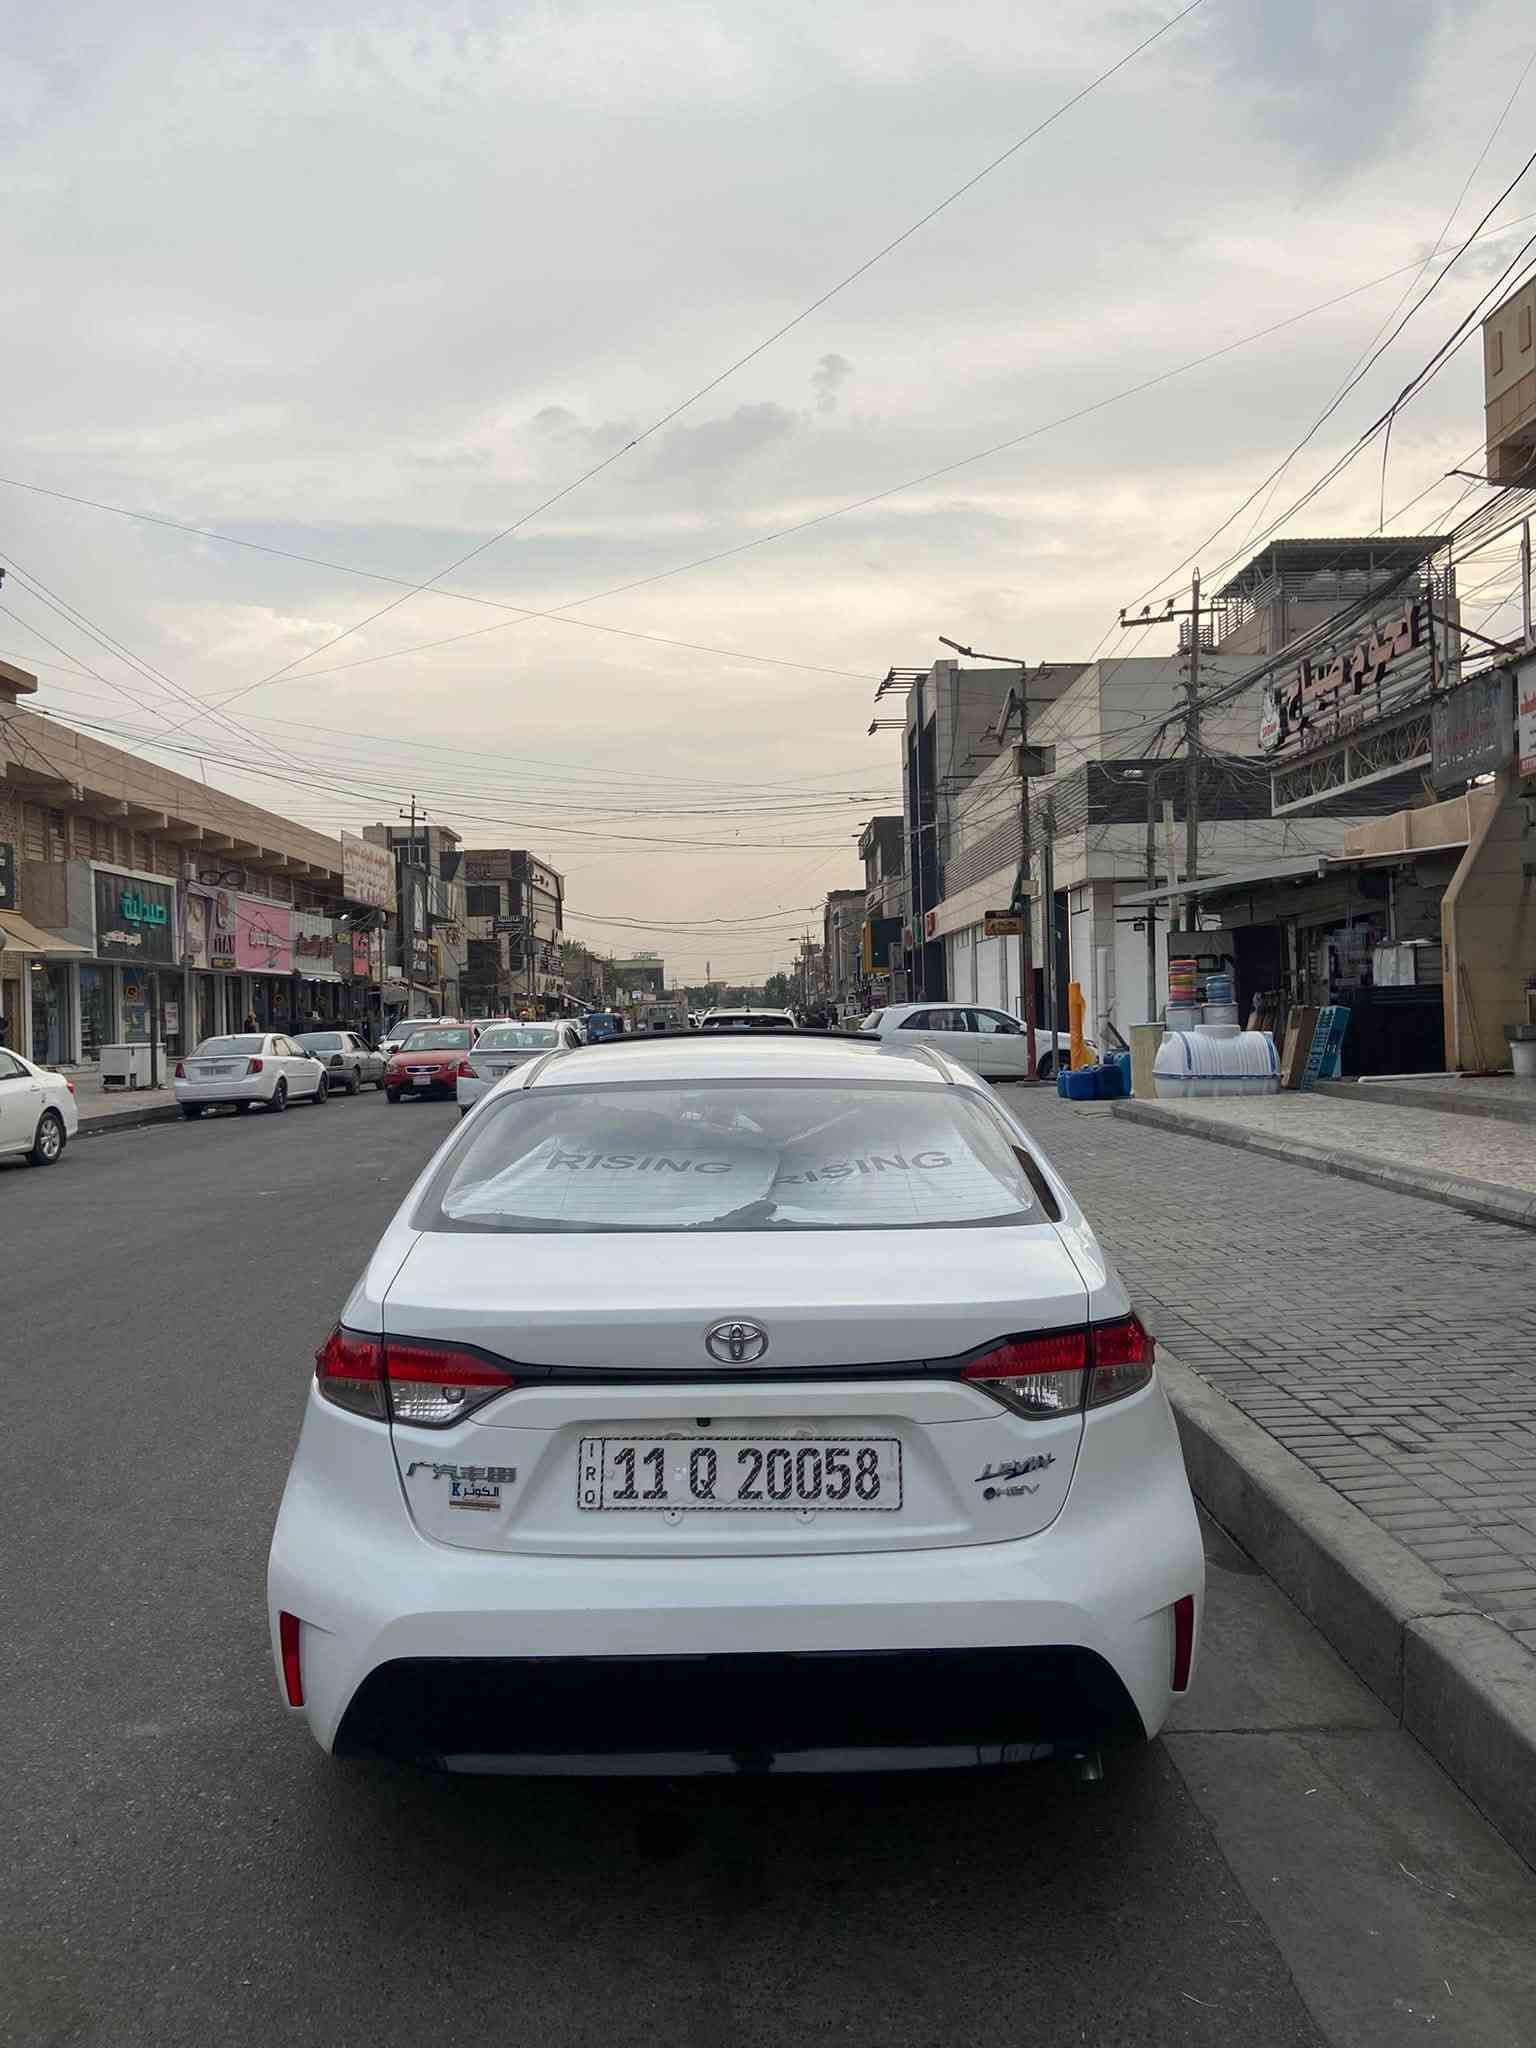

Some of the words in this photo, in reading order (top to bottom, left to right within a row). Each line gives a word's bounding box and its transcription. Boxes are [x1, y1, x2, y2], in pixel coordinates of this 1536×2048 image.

[120, 888, 167, 929] صيدلية
[545, 1151, 733, 1174] RISING
[463, 1483, 500, 1497] الكوثر
[613, 1447, 668, 1501] 11
[689, 1447, 717, 1501] Q
[736, 1447, 881, 1501] 20058
